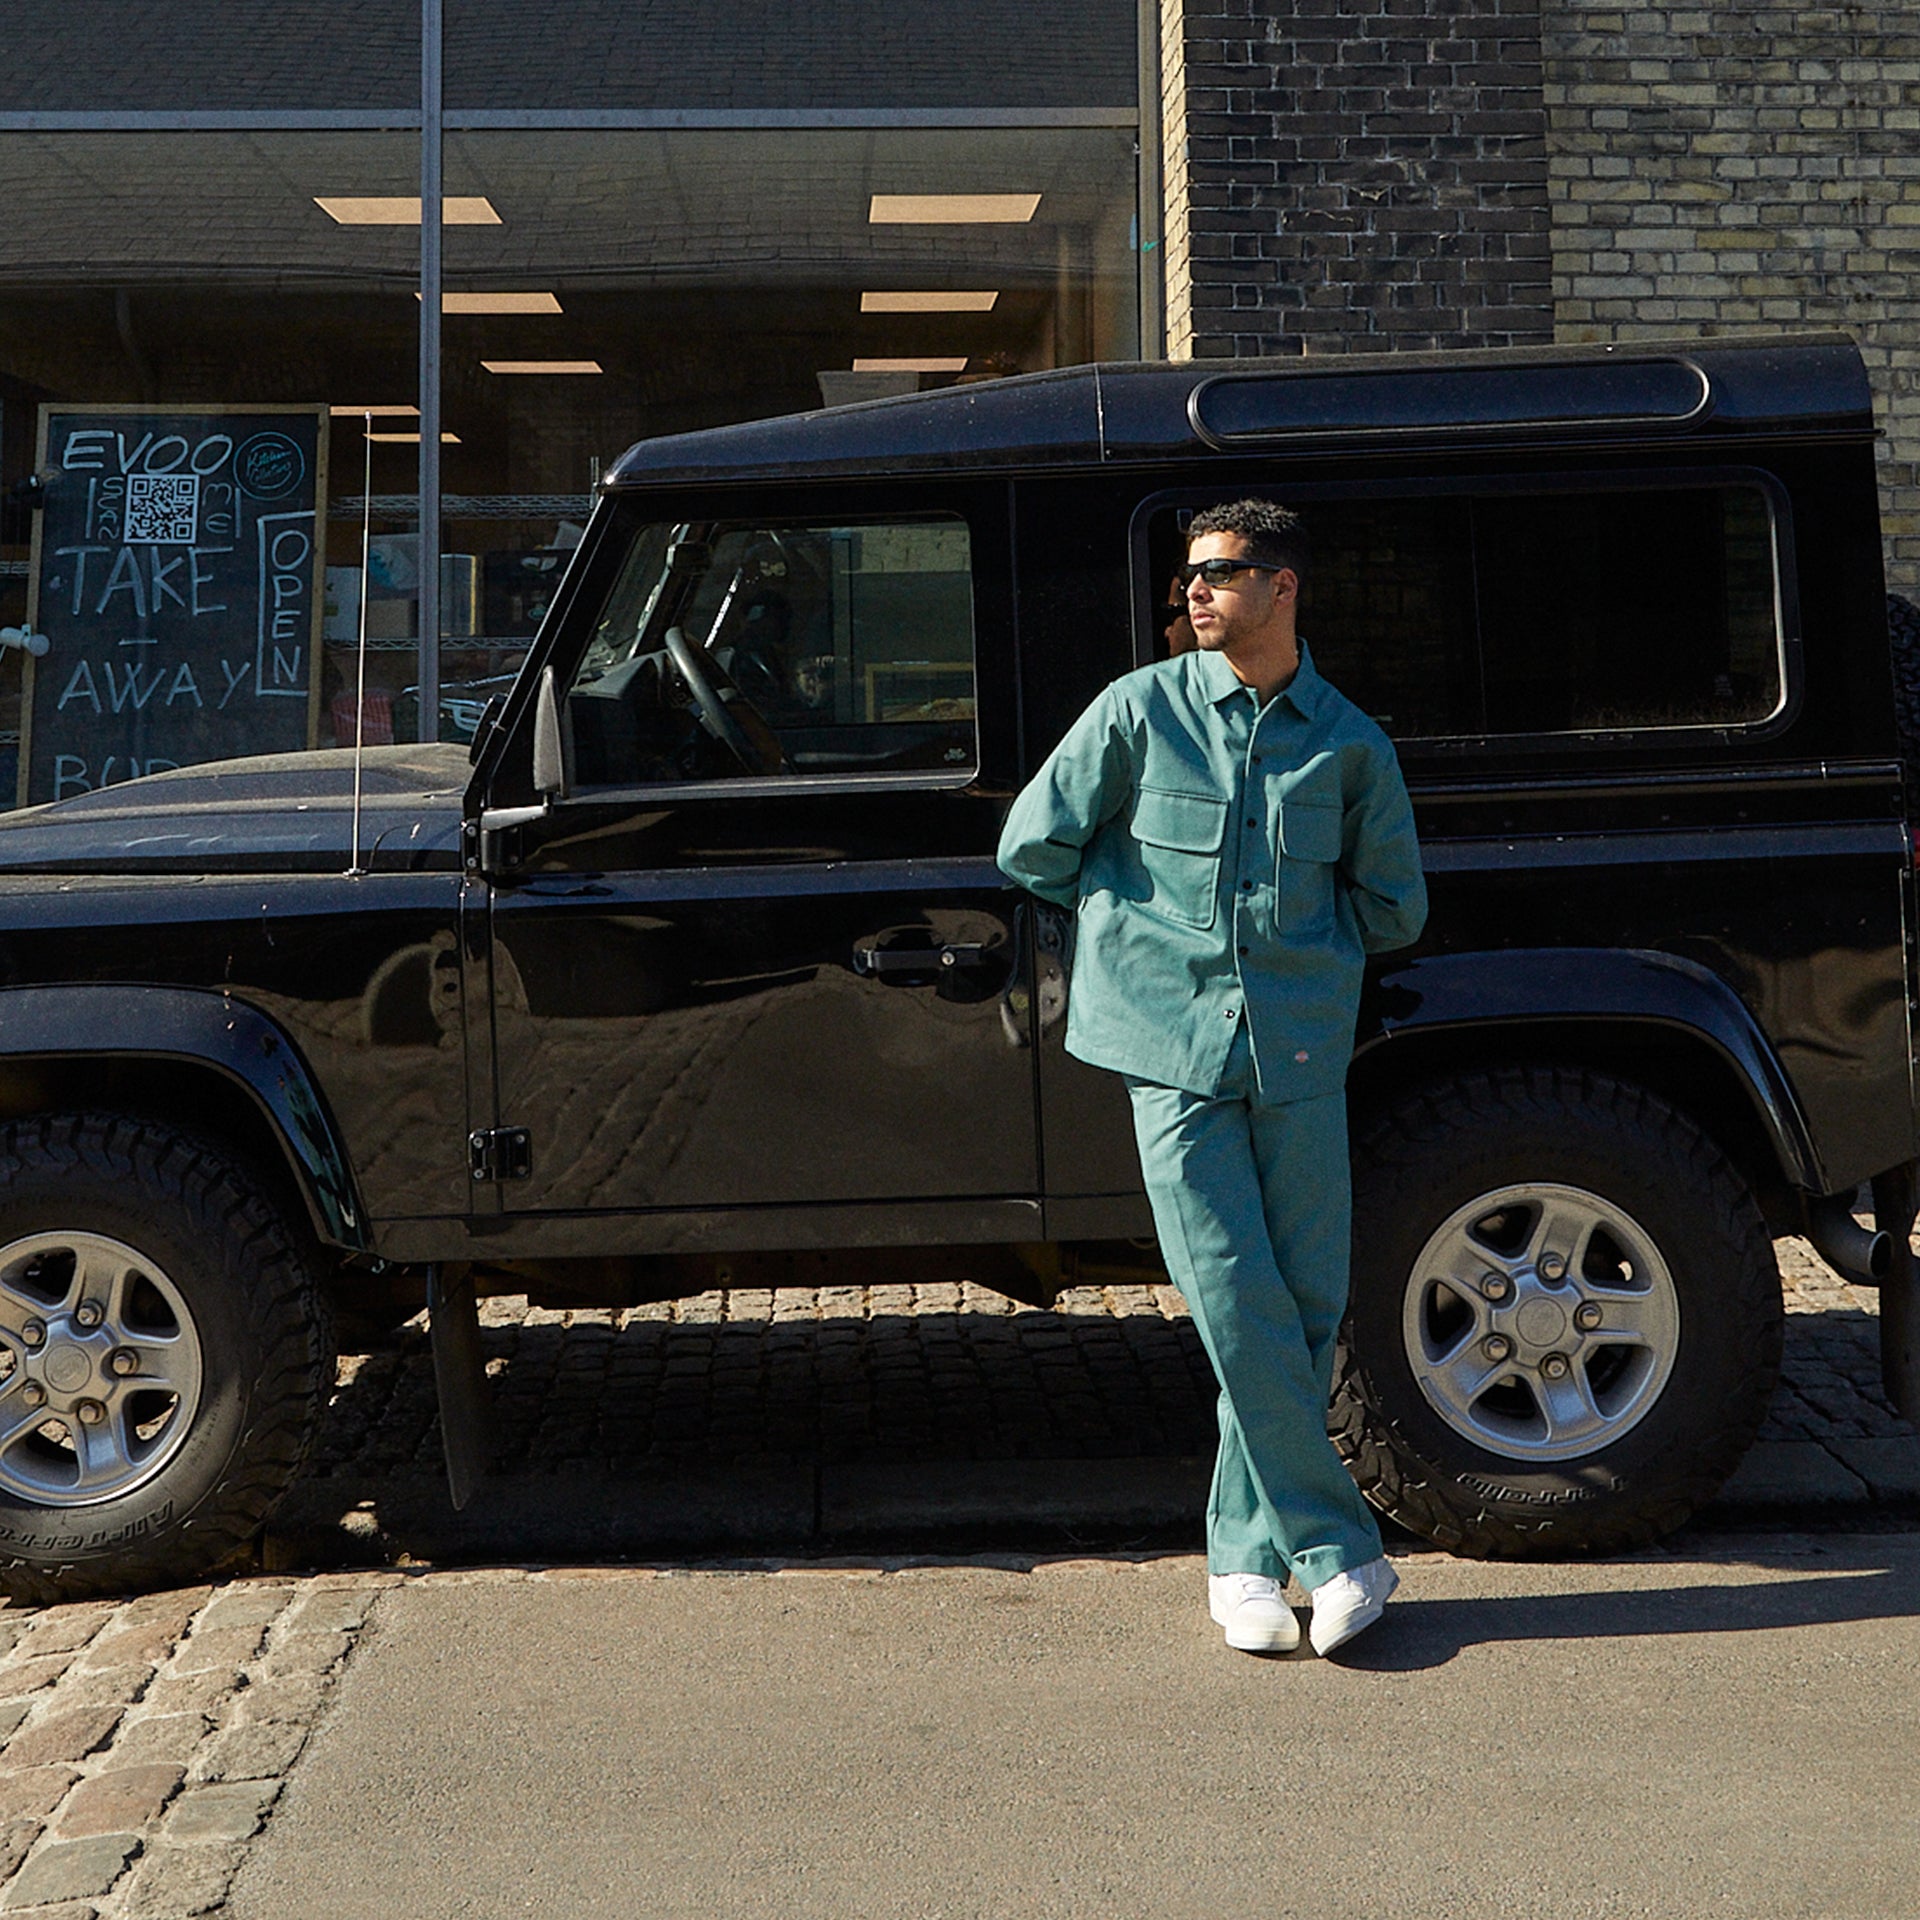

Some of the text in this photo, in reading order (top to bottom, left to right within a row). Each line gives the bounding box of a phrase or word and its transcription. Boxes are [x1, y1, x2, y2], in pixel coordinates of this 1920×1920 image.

[62, 430, 234, 475] EVOO
[94, 475, 125, 541] SCAN
[55, 546, 234, 617] TAKE
[270, 529, 310, 684] OPEN
[57, 660, 251, 713] AWAY
